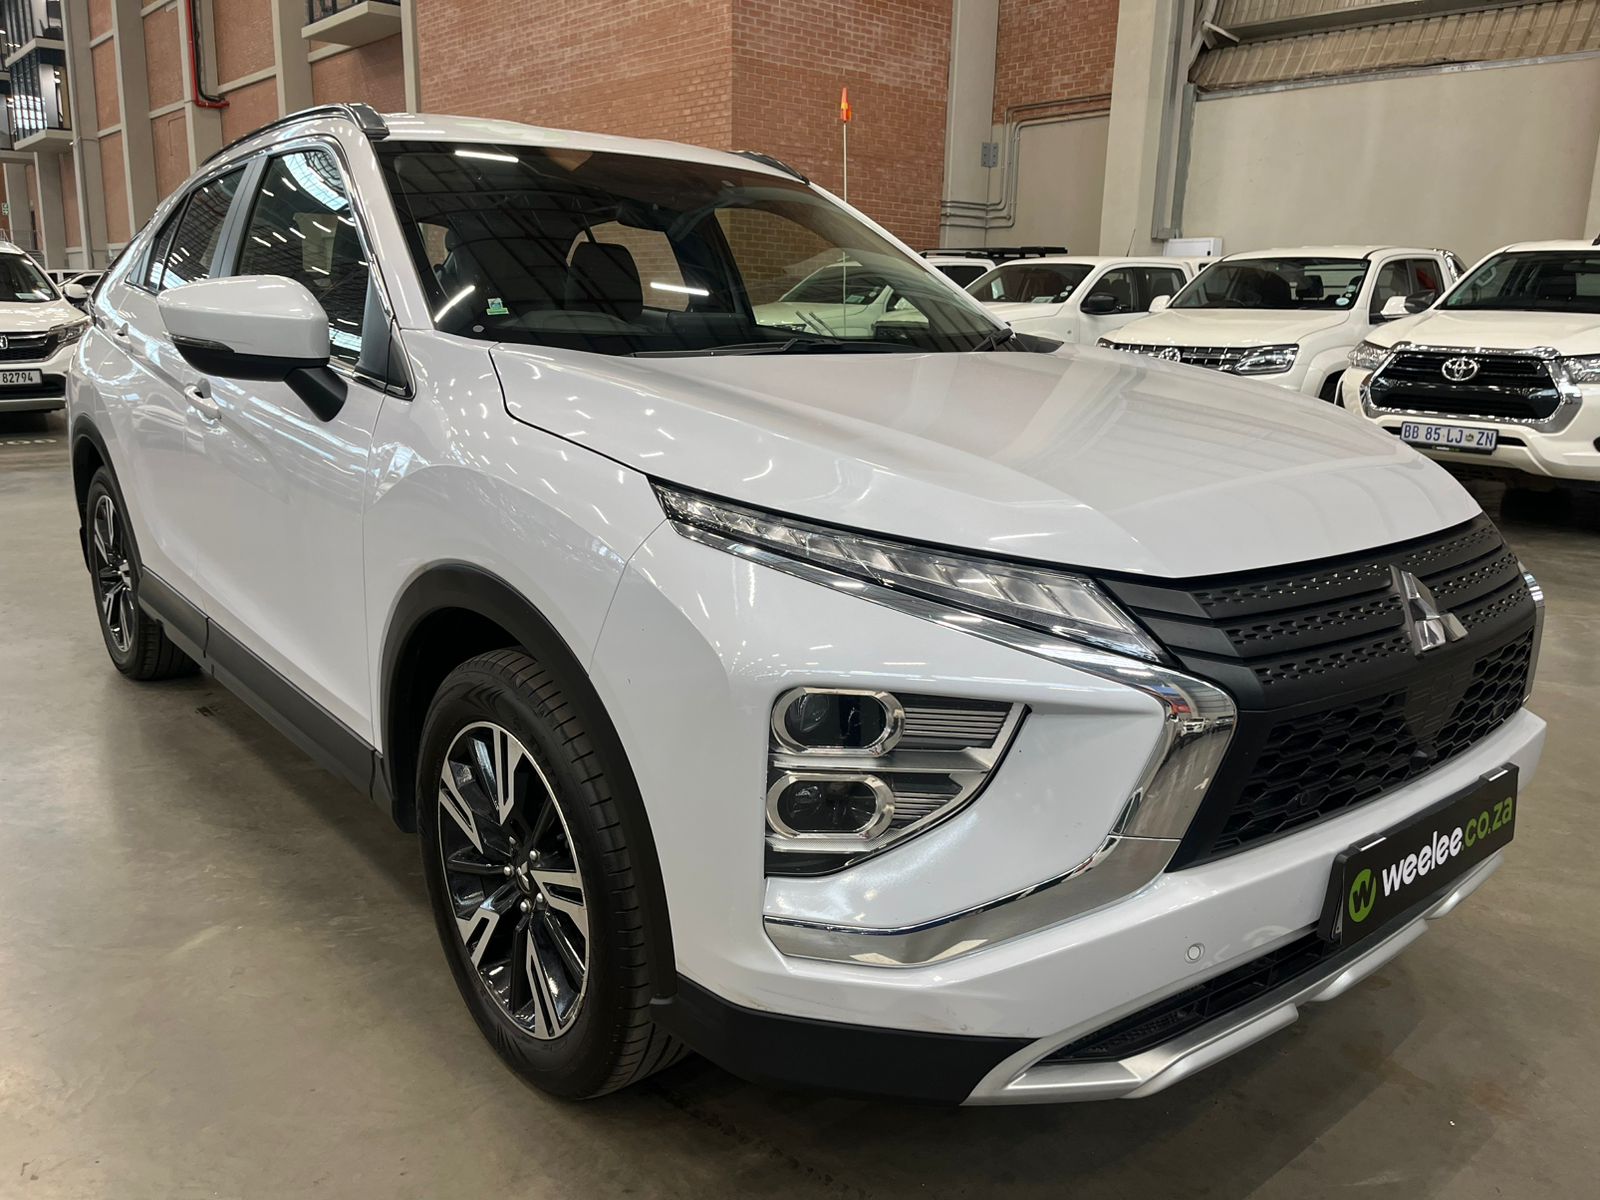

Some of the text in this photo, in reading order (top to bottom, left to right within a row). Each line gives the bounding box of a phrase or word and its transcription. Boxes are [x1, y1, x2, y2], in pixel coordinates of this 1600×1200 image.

[2, 372, 33, 383] 82794
[1403, 425, 1494, 446] BB 85 LJ ZN
[1382, 796, 1513, 897] weelee.co.za
